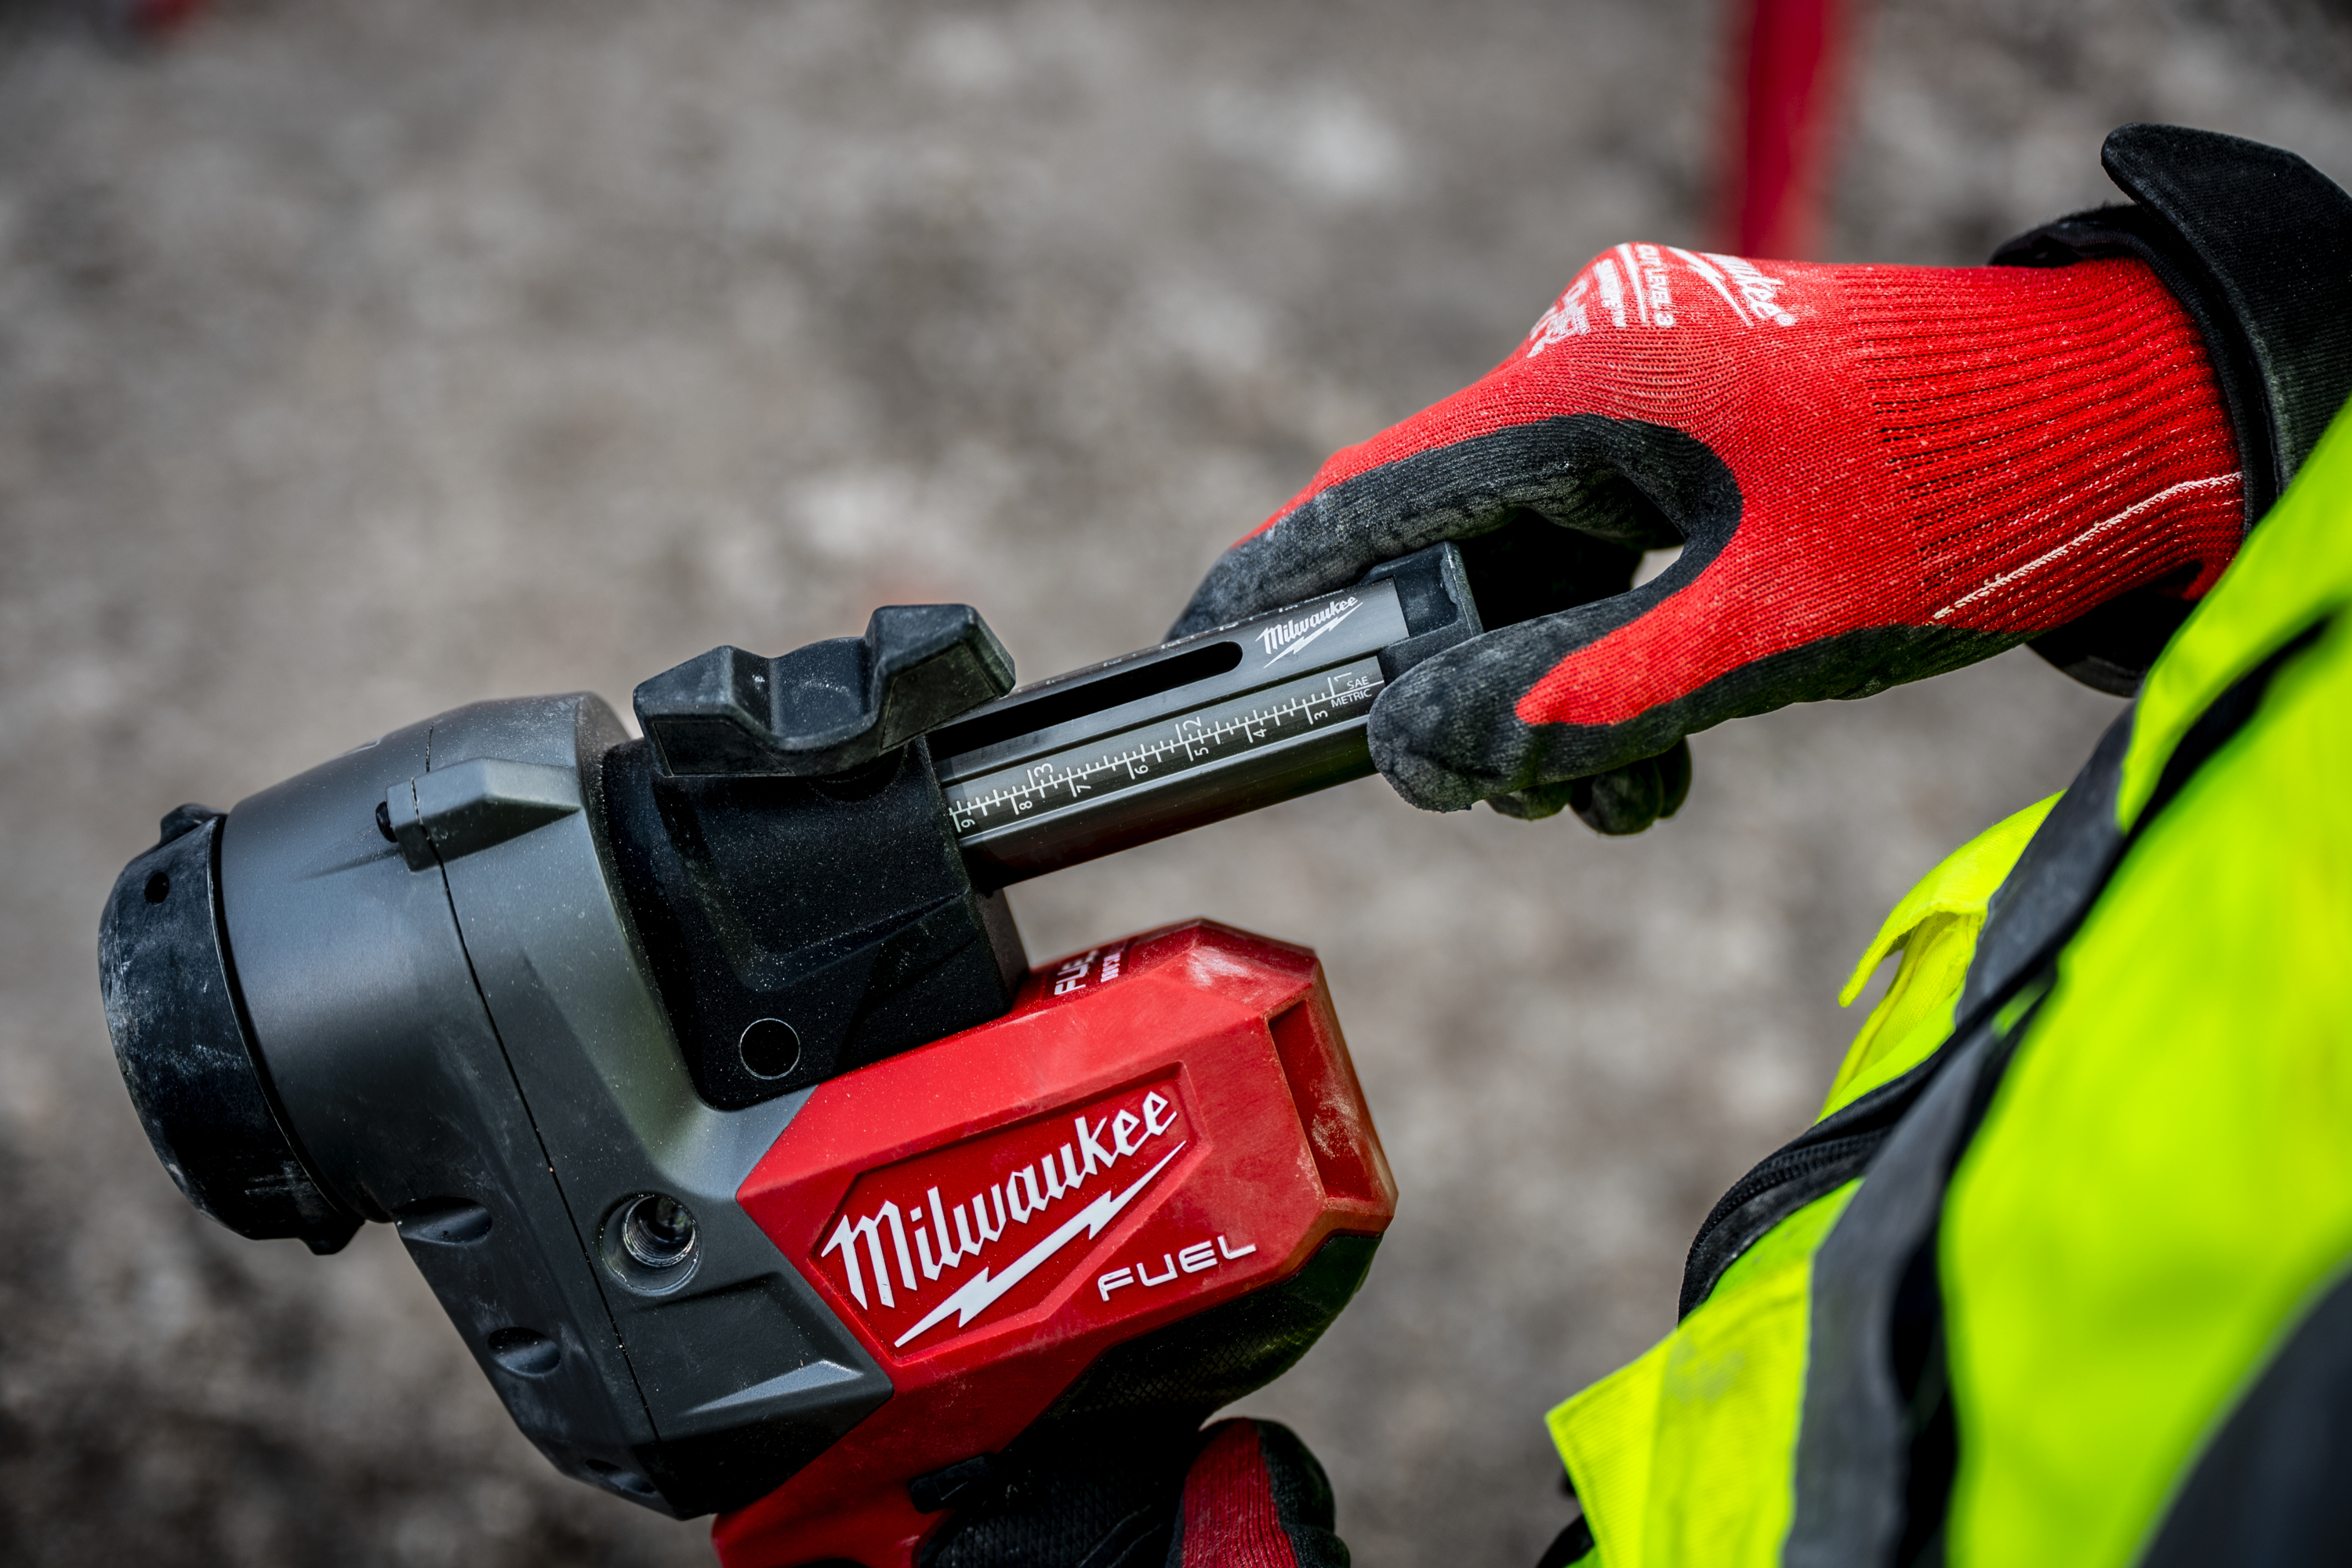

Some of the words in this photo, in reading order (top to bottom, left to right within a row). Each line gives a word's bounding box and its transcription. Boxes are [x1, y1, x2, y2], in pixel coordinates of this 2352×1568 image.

[1636, 244, 1662, 267] CUT
[1646, 267, 1671, 309] LEVEL
[1654, 312, 1675, 328] 3
[1255, 596, 1359, 655] Milwaukee
[1330, 688, 1373, 708] METRIC
[1346, 676, 1370, 690] SAE
[1033, 762, 1054, 778] 3
[1182, 716, 1202, 731] 2
[1333, 671, 1352, 682] 1
[960, 818, 976, 829] 9
[1018, 800, 1033, 811] 8
[1076, 784, 1091, 793] 7
[1134, 764, 1149, 775] 6
[1193, 746, 1210, 757] 5
[1252, 728, 1268, 739] 4
[1313, 710, 1329, 720] 3
[822, 1091, 1177, 1310] Milwaukee
[1098, 1235, 1257, 1302] FUEL
